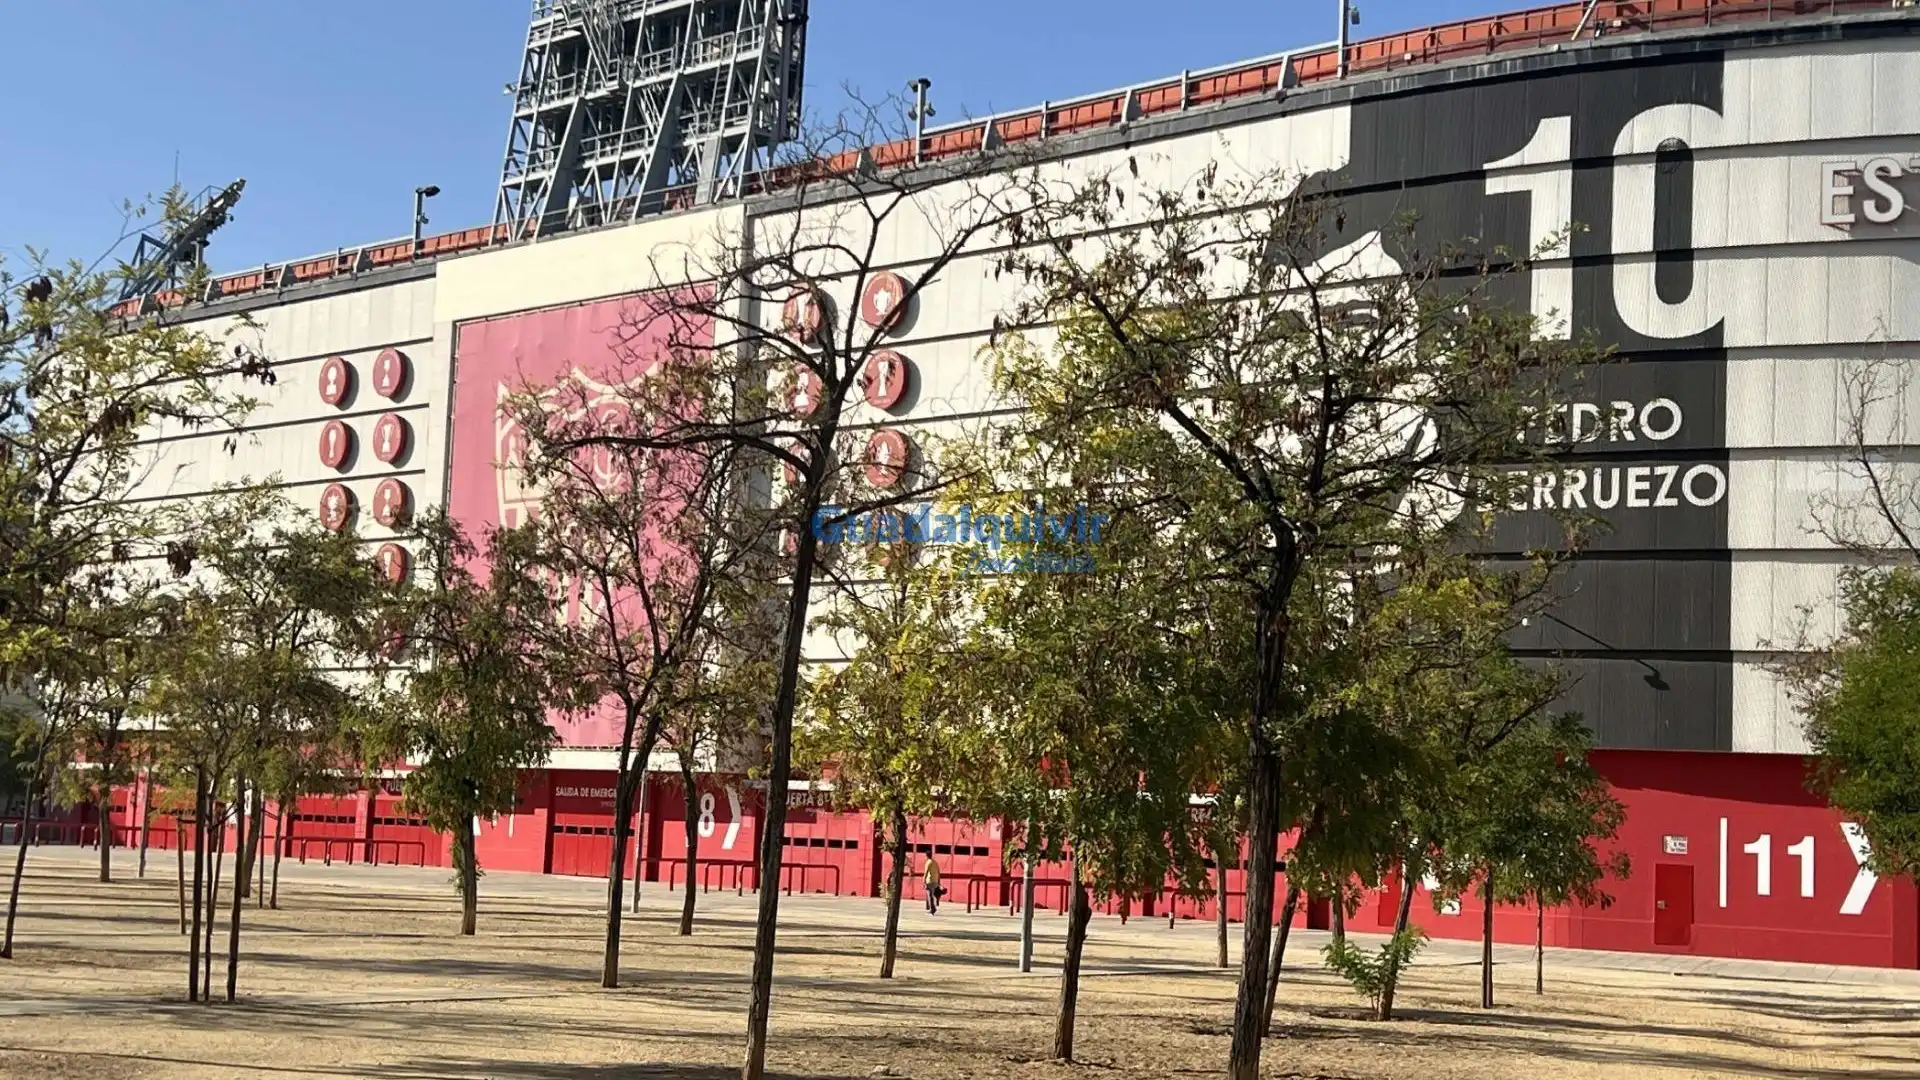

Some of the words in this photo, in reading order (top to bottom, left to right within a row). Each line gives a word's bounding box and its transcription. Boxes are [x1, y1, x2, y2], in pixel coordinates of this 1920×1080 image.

[1483, 103, 1725, 341] 10
[1821, 157, 1920, 223] ES
[580, 787, 588, 797] DE
[698, 792, 715, 838] 8
[1743, 834, 1815, 898] 11
